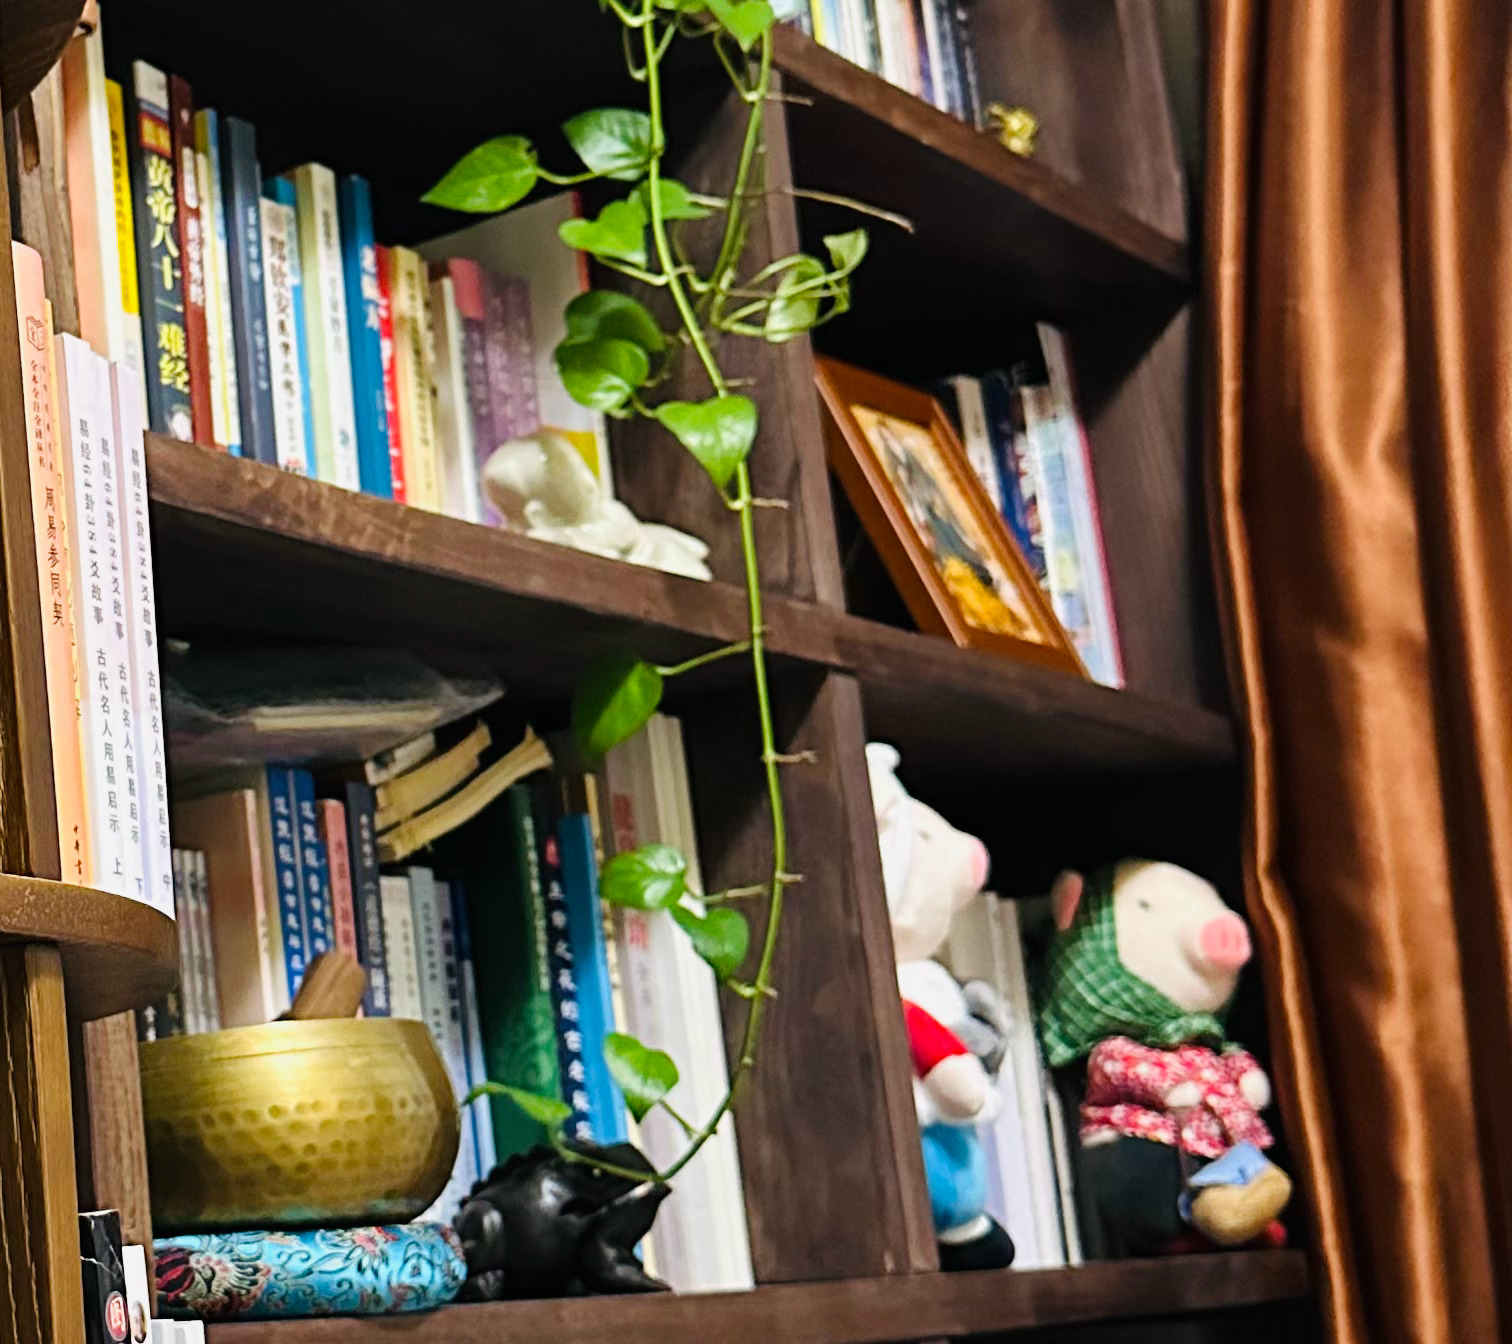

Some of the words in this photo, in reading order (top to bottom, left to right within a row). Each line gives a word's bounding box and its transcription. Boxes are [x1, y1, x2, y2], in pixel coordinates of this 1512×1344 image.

[45, 486, 64, 627] 周易参同契
[96, 648, 120, 833] 古代名人用易启示
[113, 858, 123, 876] 上
[118, 662, 140, 844] 古代名人用易启示
[147, 670, 169, 849] 古代名人用易启示
